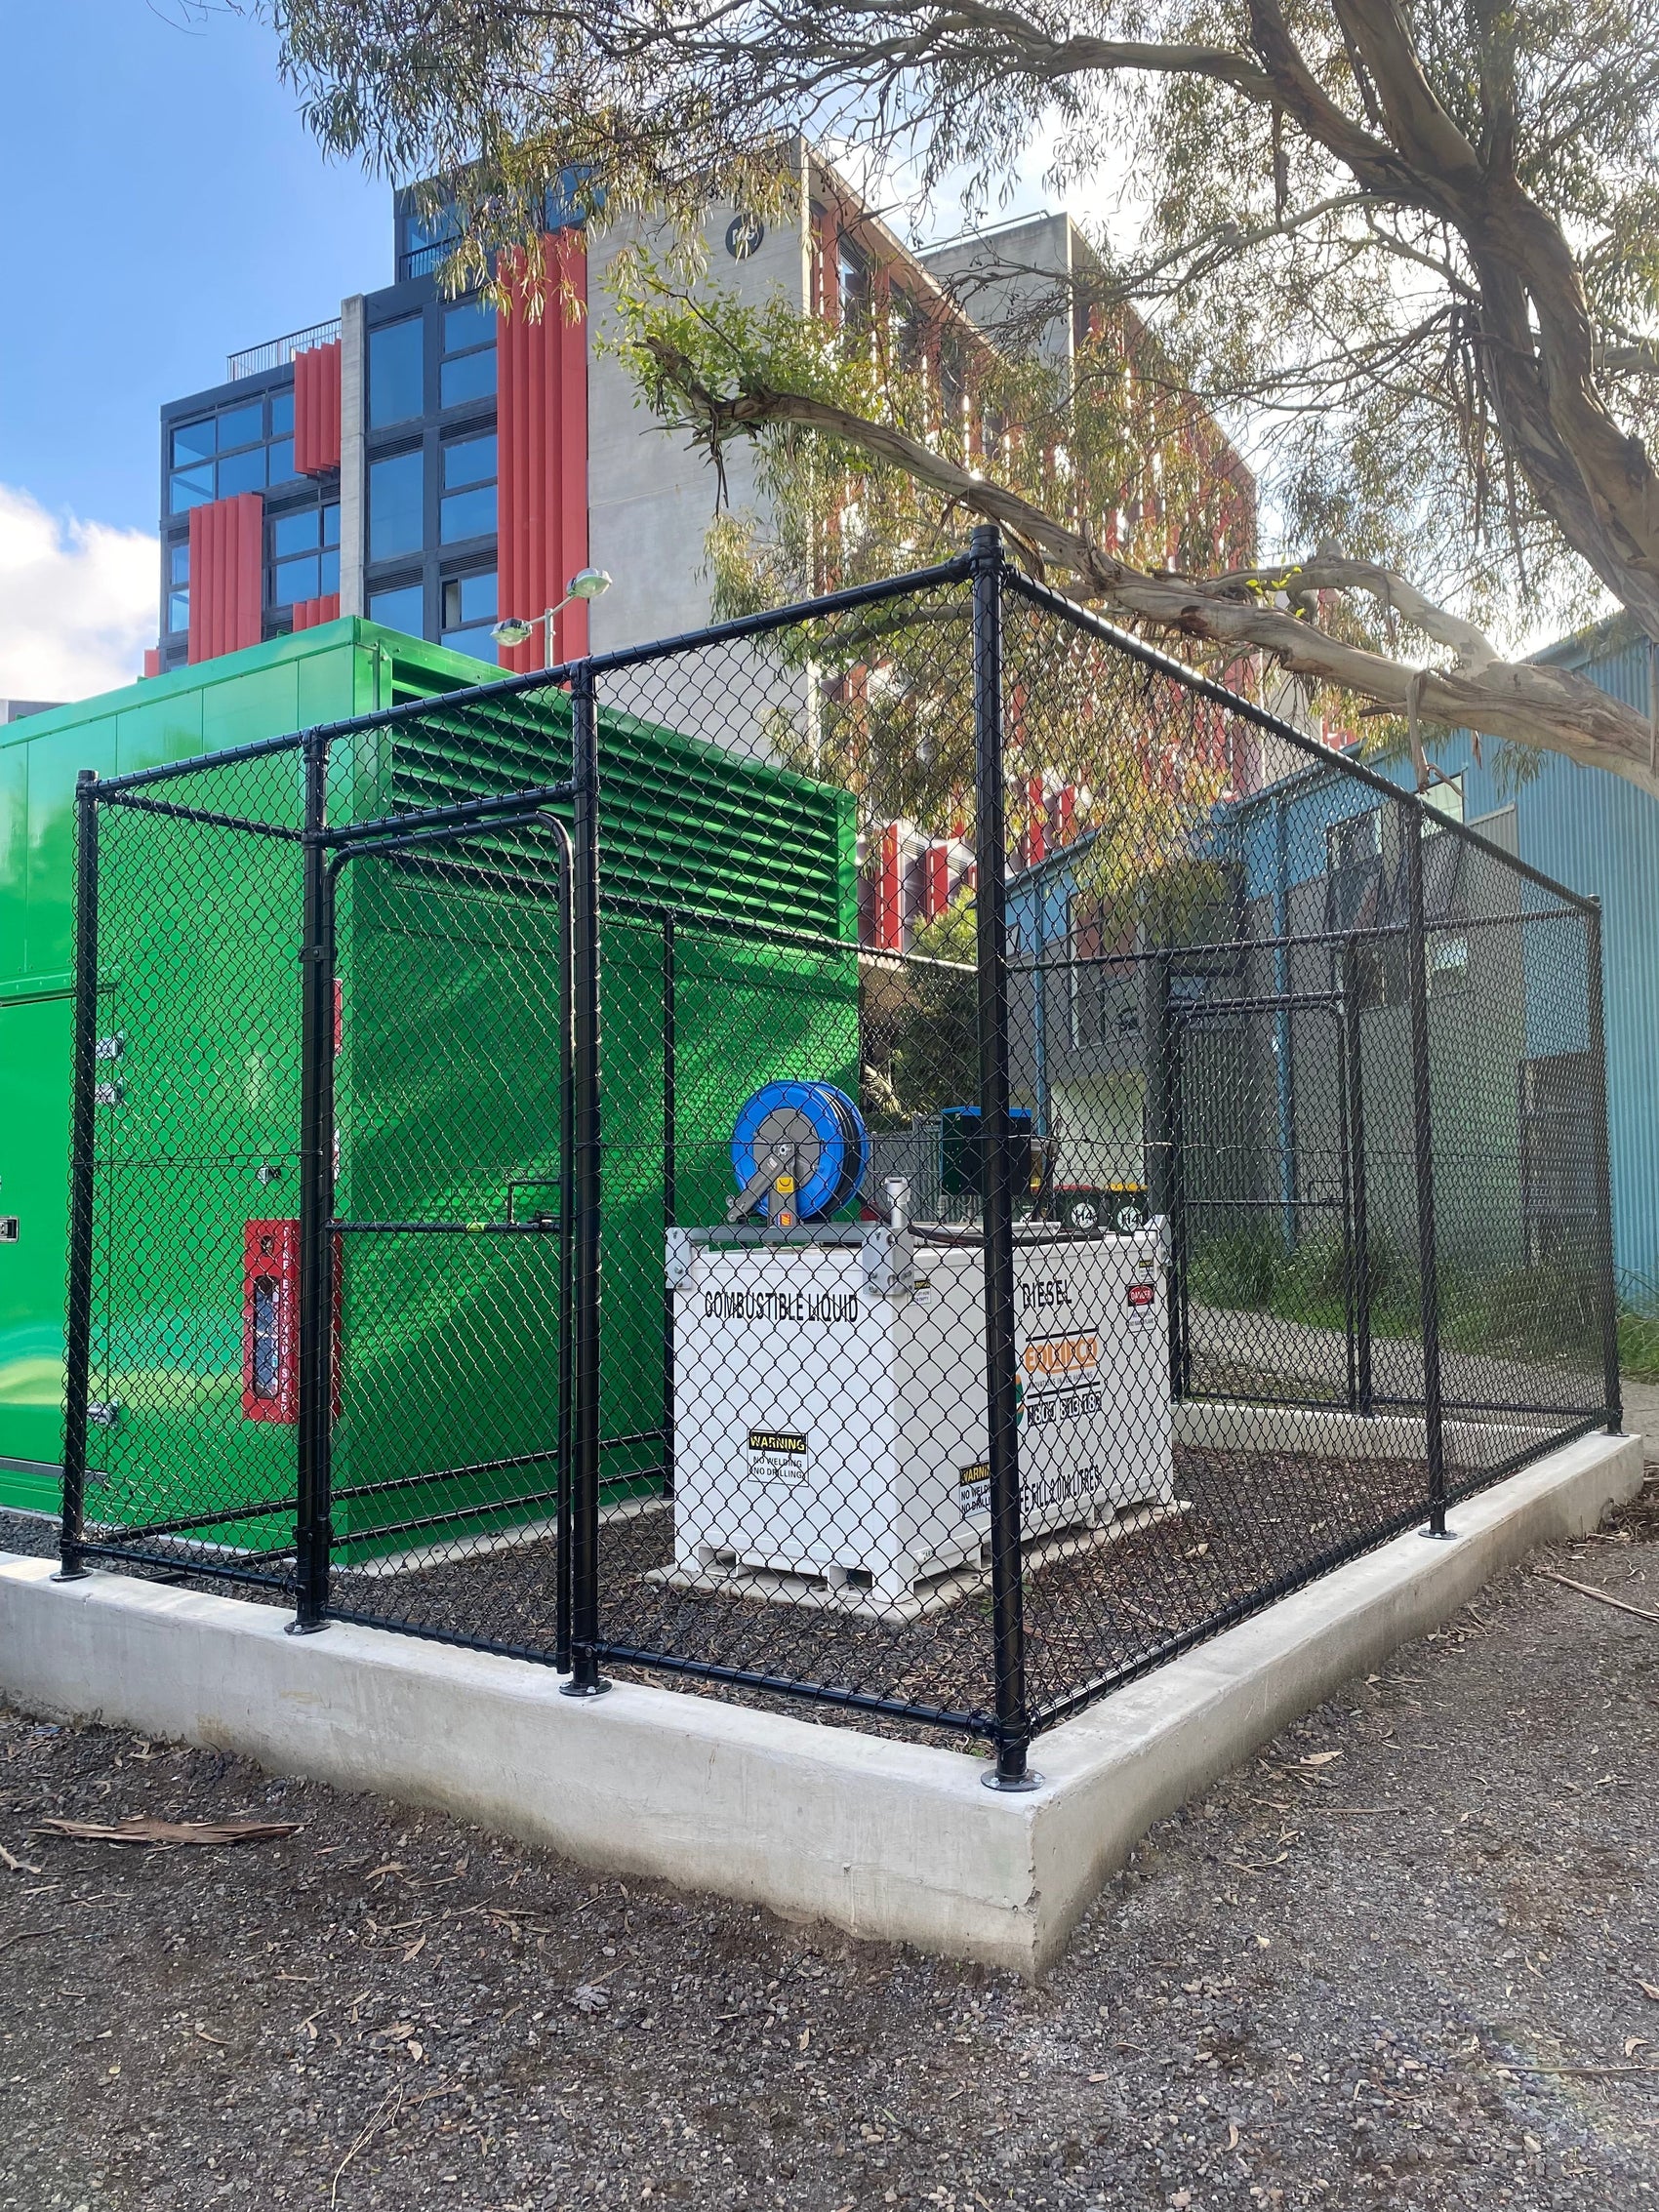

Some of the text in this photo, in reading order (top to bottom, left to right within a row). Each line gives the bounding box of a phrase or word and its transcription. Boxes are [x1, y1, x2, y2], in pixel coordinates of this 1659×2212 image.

[1023, 1279, 1072, 1308] DIESEL
[1130, 1290, 1151, 1301] DANGER
[705, 1290, 858, 1322] COMBUSTIBLE LIQUID
[1025, 1338, 1098, 1372] EQUIPCO
[750, 1436, 805, 1451] WARNING
[767, 1457, 802, 1468] WELDING
[767, 1468, 802, 1478] DRILLING
[962, 1465, 990, 1482] WARNI
[961, 1483, 991, 1501] NO WELDI
[961, 1496, 991, 1514] NO DRILL
